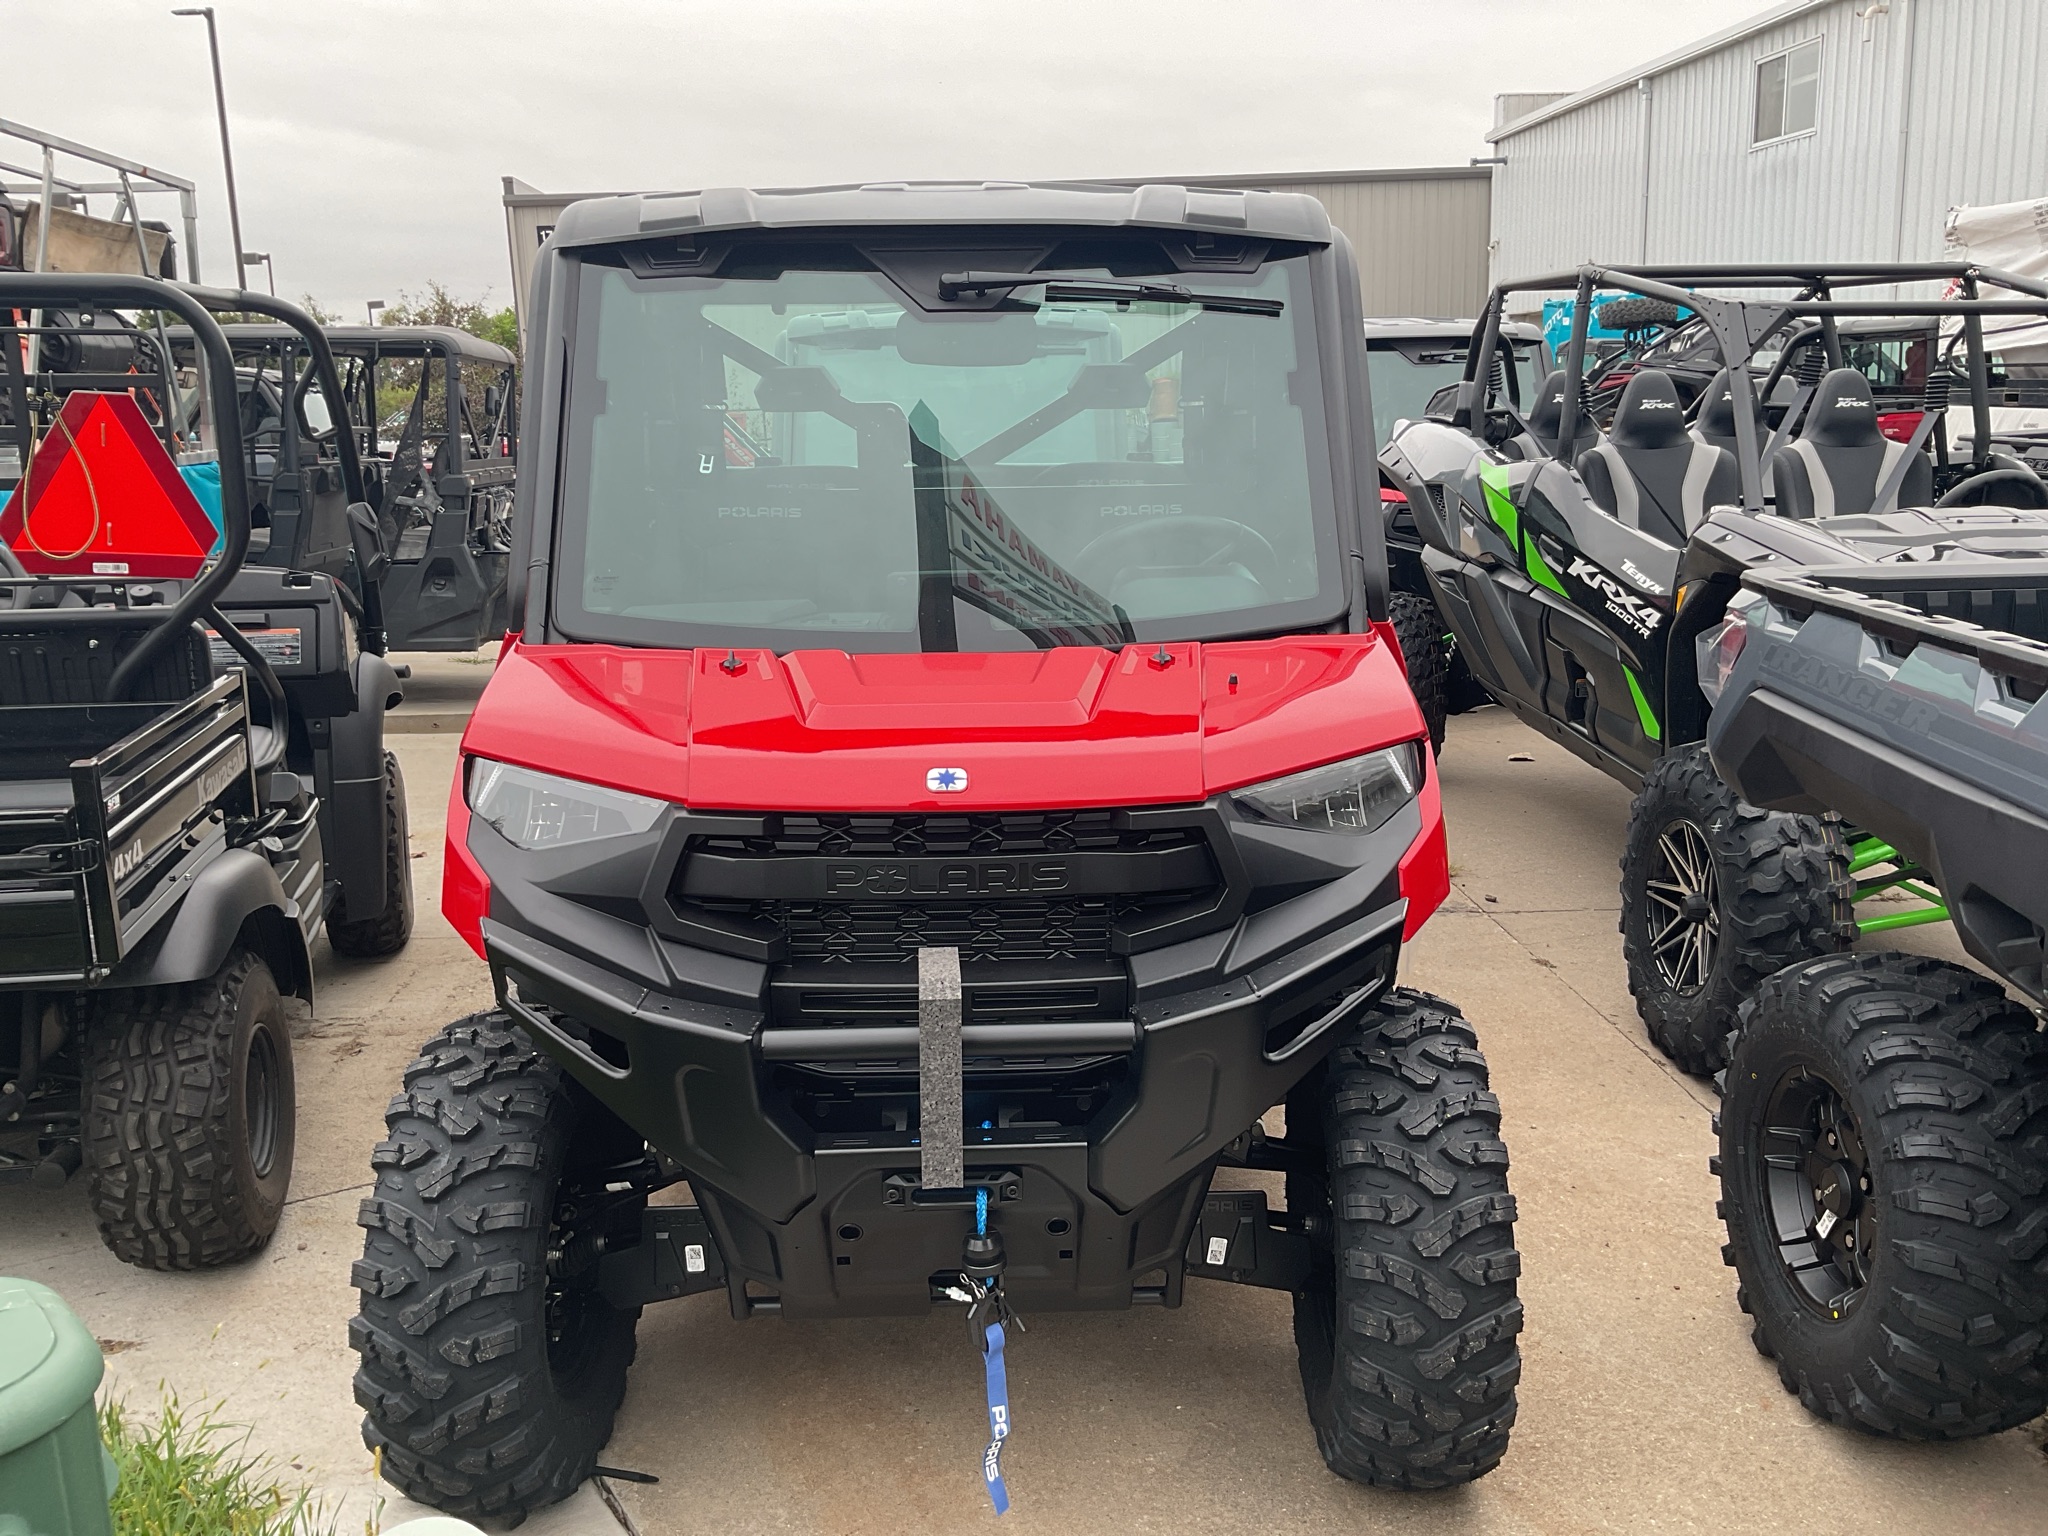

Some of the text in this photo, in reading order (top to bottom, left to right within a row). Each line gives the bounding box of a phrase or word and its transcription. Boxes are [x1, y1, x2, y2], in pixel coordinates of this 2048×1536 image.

[1639, 402, 1675, 410] KRX
[718, 506, 802, 518] POLARIS
[1100, 504, 1182, 517] POLARIS
[1769, 645, 1940, 734] RANGER
[197, 740, 247, 806] Kawasaki
[113, 838, 145, 883] 4x4
[826, 861, 1070, 894] POLARIS
[1203, 1200, 1256, 1213] ARIS
[985, 1404, 1008, 1482] POARIS
